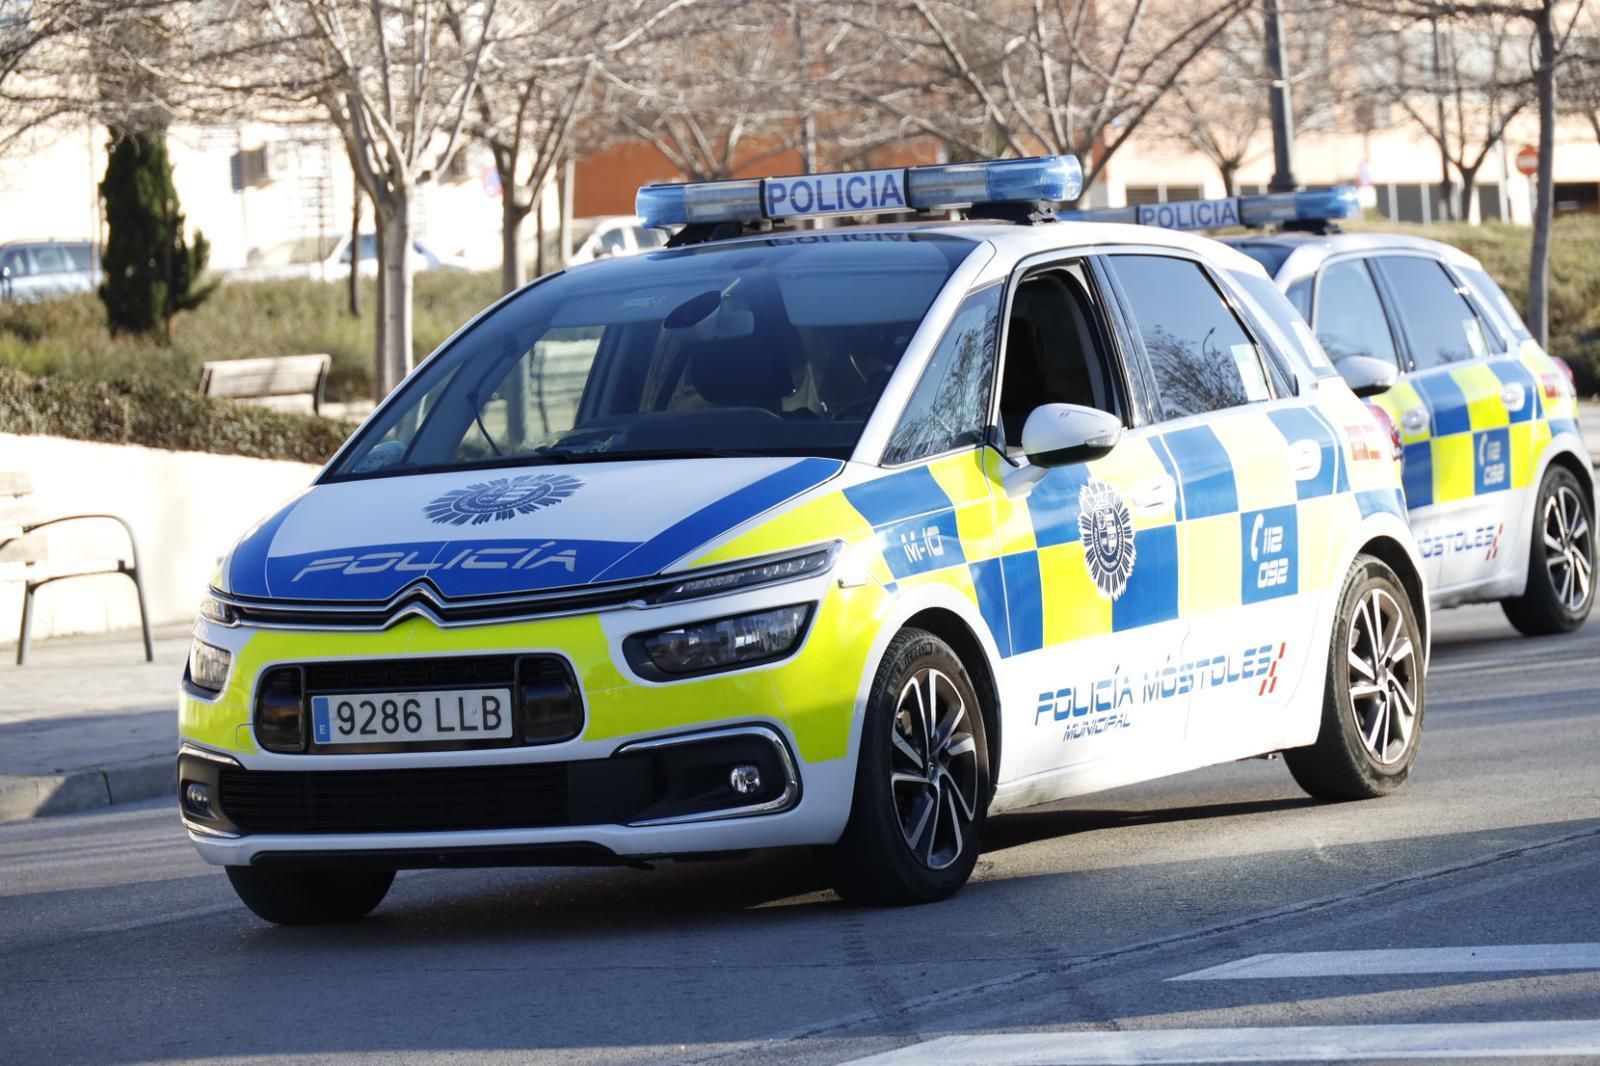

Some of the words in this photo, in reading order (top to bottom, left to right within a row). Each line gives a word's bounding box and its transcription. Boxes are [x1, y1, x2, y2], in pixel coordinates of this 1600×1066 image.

[767, 172, 904, 214] POLICIA
[1142, 202, 1237, 228] POLICIA
[1263, 526, 1283, 554] 112
[291, 541, 577, 582] POLICÍA
[1257, 558, 1289, 588] 092
[1035, 664, 1133, 726] POLICÍA
[1143, 644, 1272, 704] MÓSTOLES
[319, 725, 326, 735] E
[336, 699, 422, 736] 9286
[435, 695, 502, 733] LLB
[1063, 713, 1131, 742] MUNICIPAL
